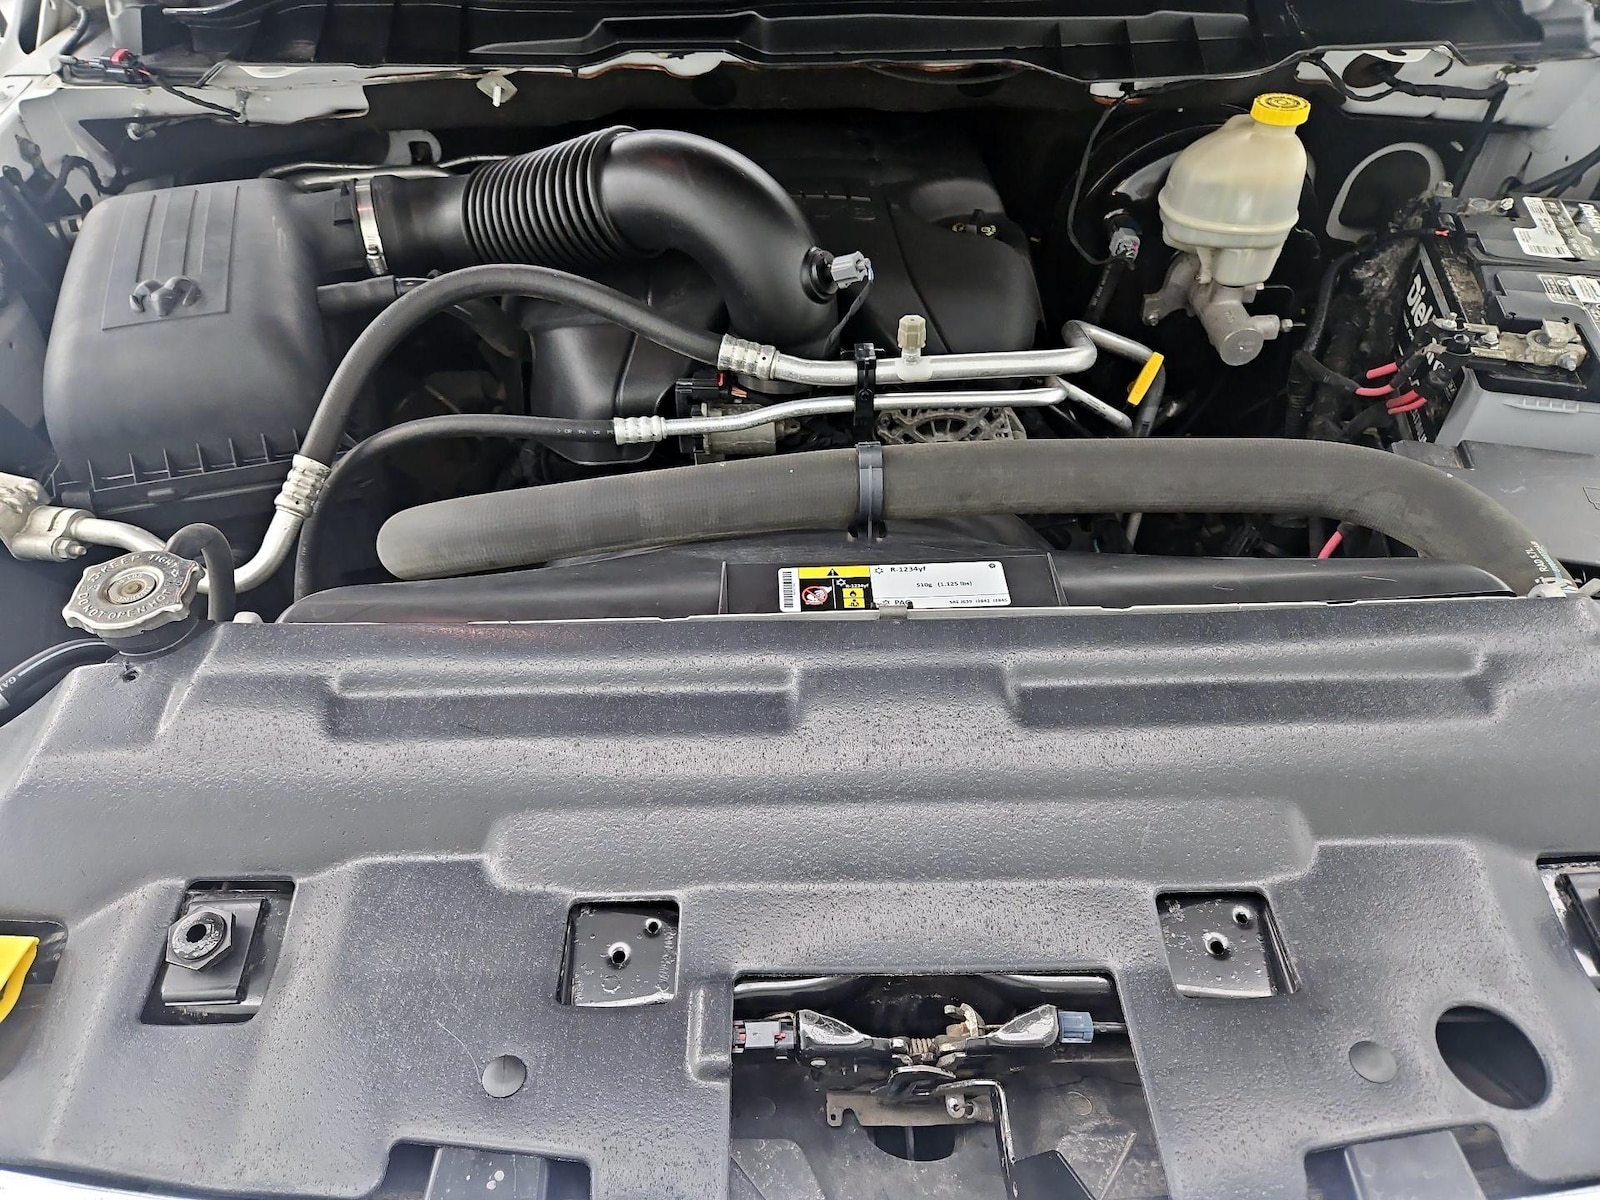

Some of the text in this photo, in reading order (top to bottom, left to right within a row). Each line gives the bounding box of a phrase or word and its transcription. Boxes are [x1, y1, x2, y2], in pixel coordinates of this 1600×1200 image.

[101, 554, 179, 573] KEEP TIGHT
[1533, 559, 1549, 572] RAD
[107, 606, 147, 620] OPEN
[149, 589, 171, 607] HOT
